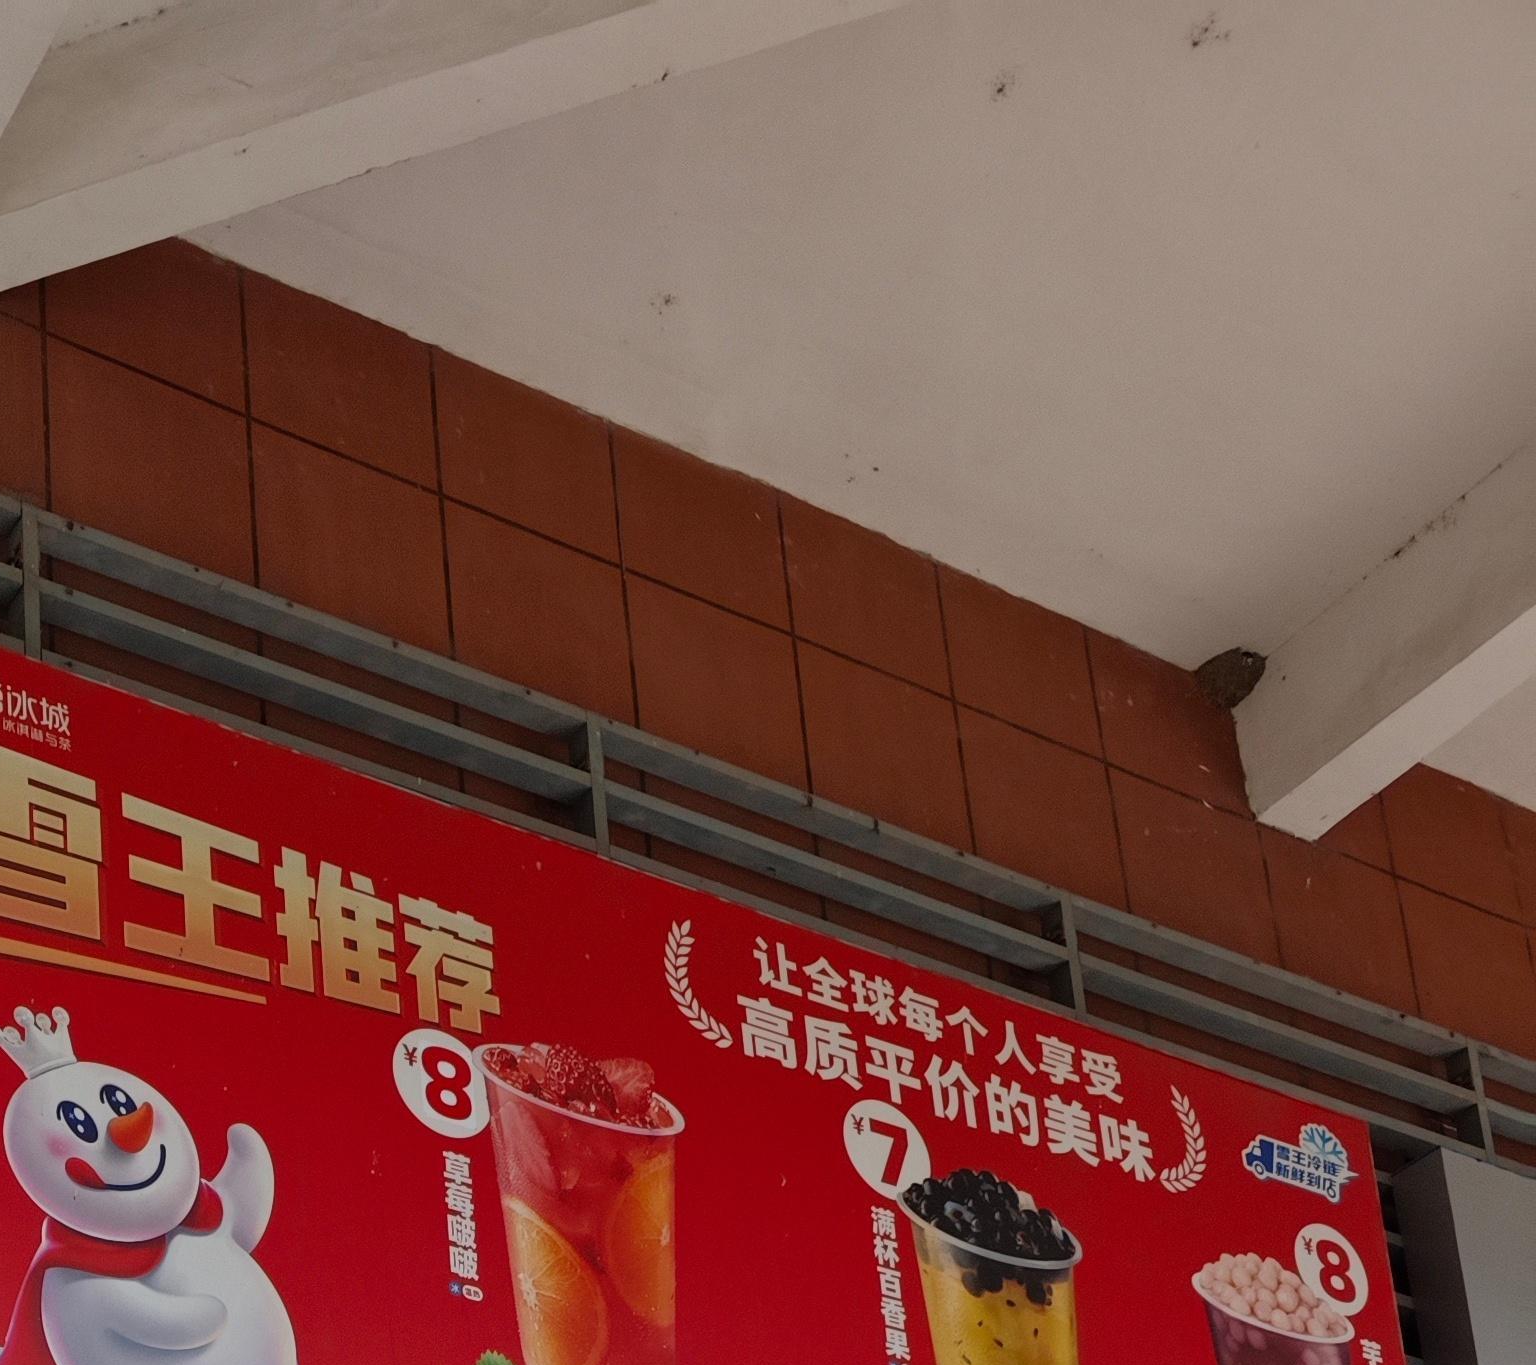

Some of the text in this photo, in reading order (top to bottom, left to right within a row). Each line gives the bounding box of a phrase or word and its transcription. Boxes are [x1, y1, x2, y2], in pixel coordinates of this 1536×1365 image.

[736, 994, 1156, 1183] 高质平价的美味
[752, 936, 1124, 1104] 让全球每个人享受
[1275, 1160, 1337, 1199] 新鲜到店
[870, 1206, 911, 1361] 满杯百香果
